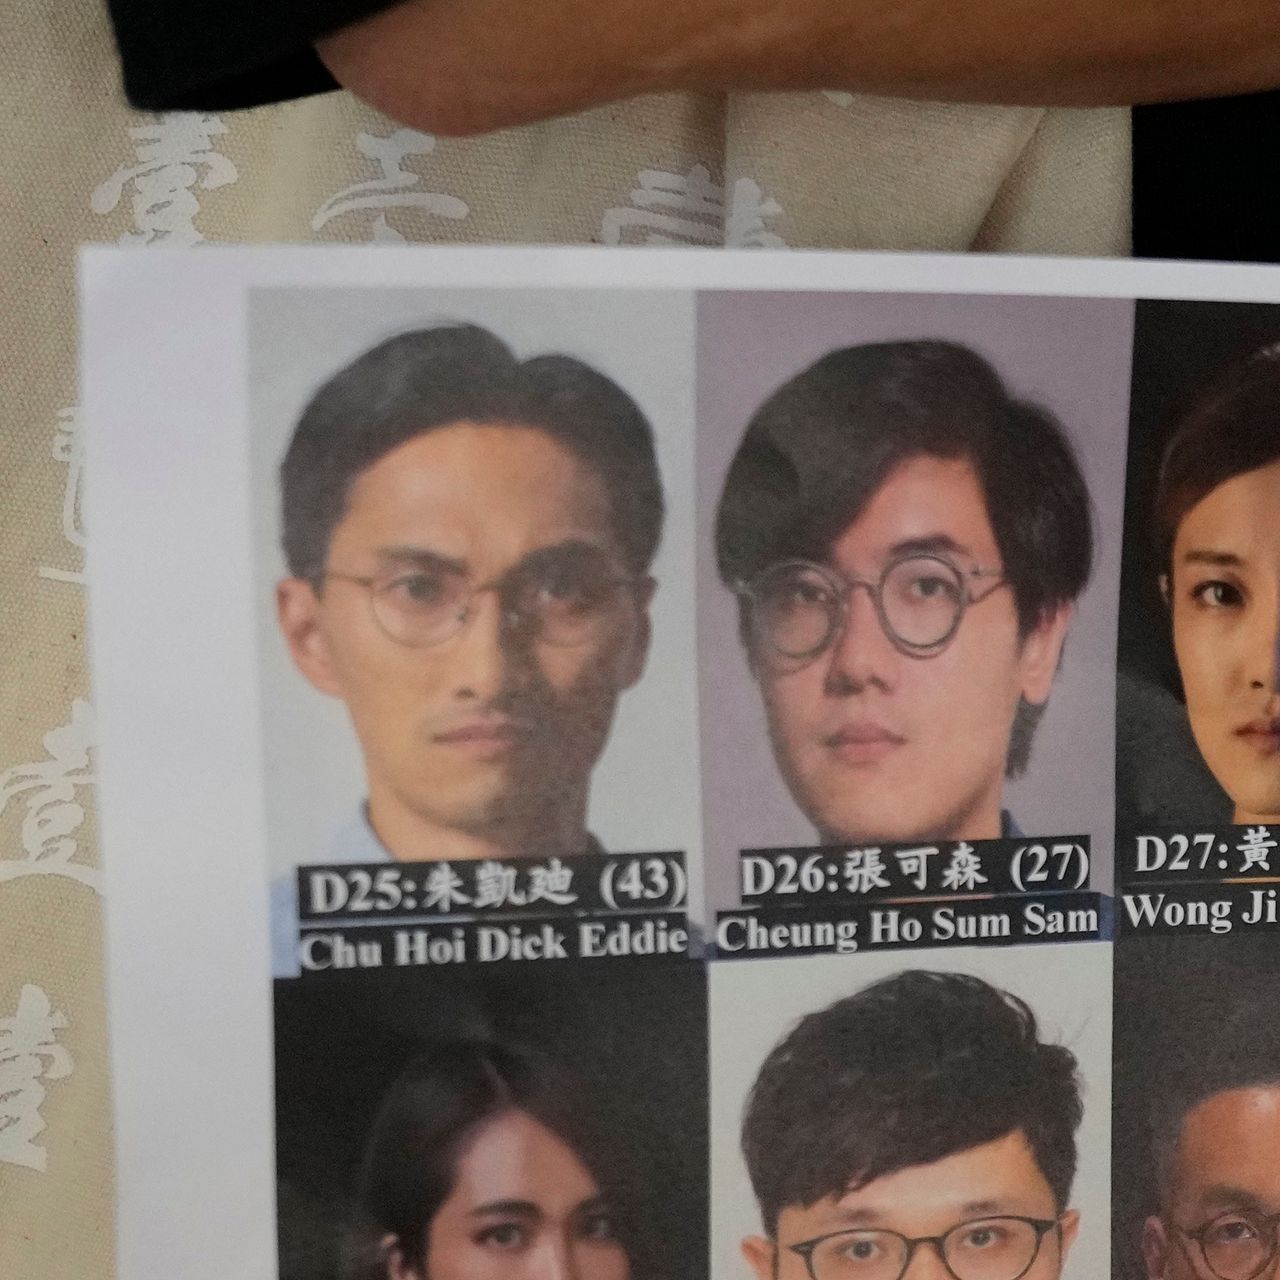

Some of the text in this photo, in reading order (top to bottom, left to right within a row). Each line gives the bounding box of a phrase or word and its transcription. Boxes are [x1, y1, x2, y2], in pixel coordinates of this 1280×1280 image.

[601, 857, 688, 910] (43)
[740, 845, 1091, 896] D26:張可森 (27)
[717, 900, 1099, 954] Cheung Ho Sum Sam
[1123, 893, 1233, 934] Wong
[1241, 893, 1280, 926] Ji
[300, 920, 689, 970] Chu Hoi Dick Eddie
